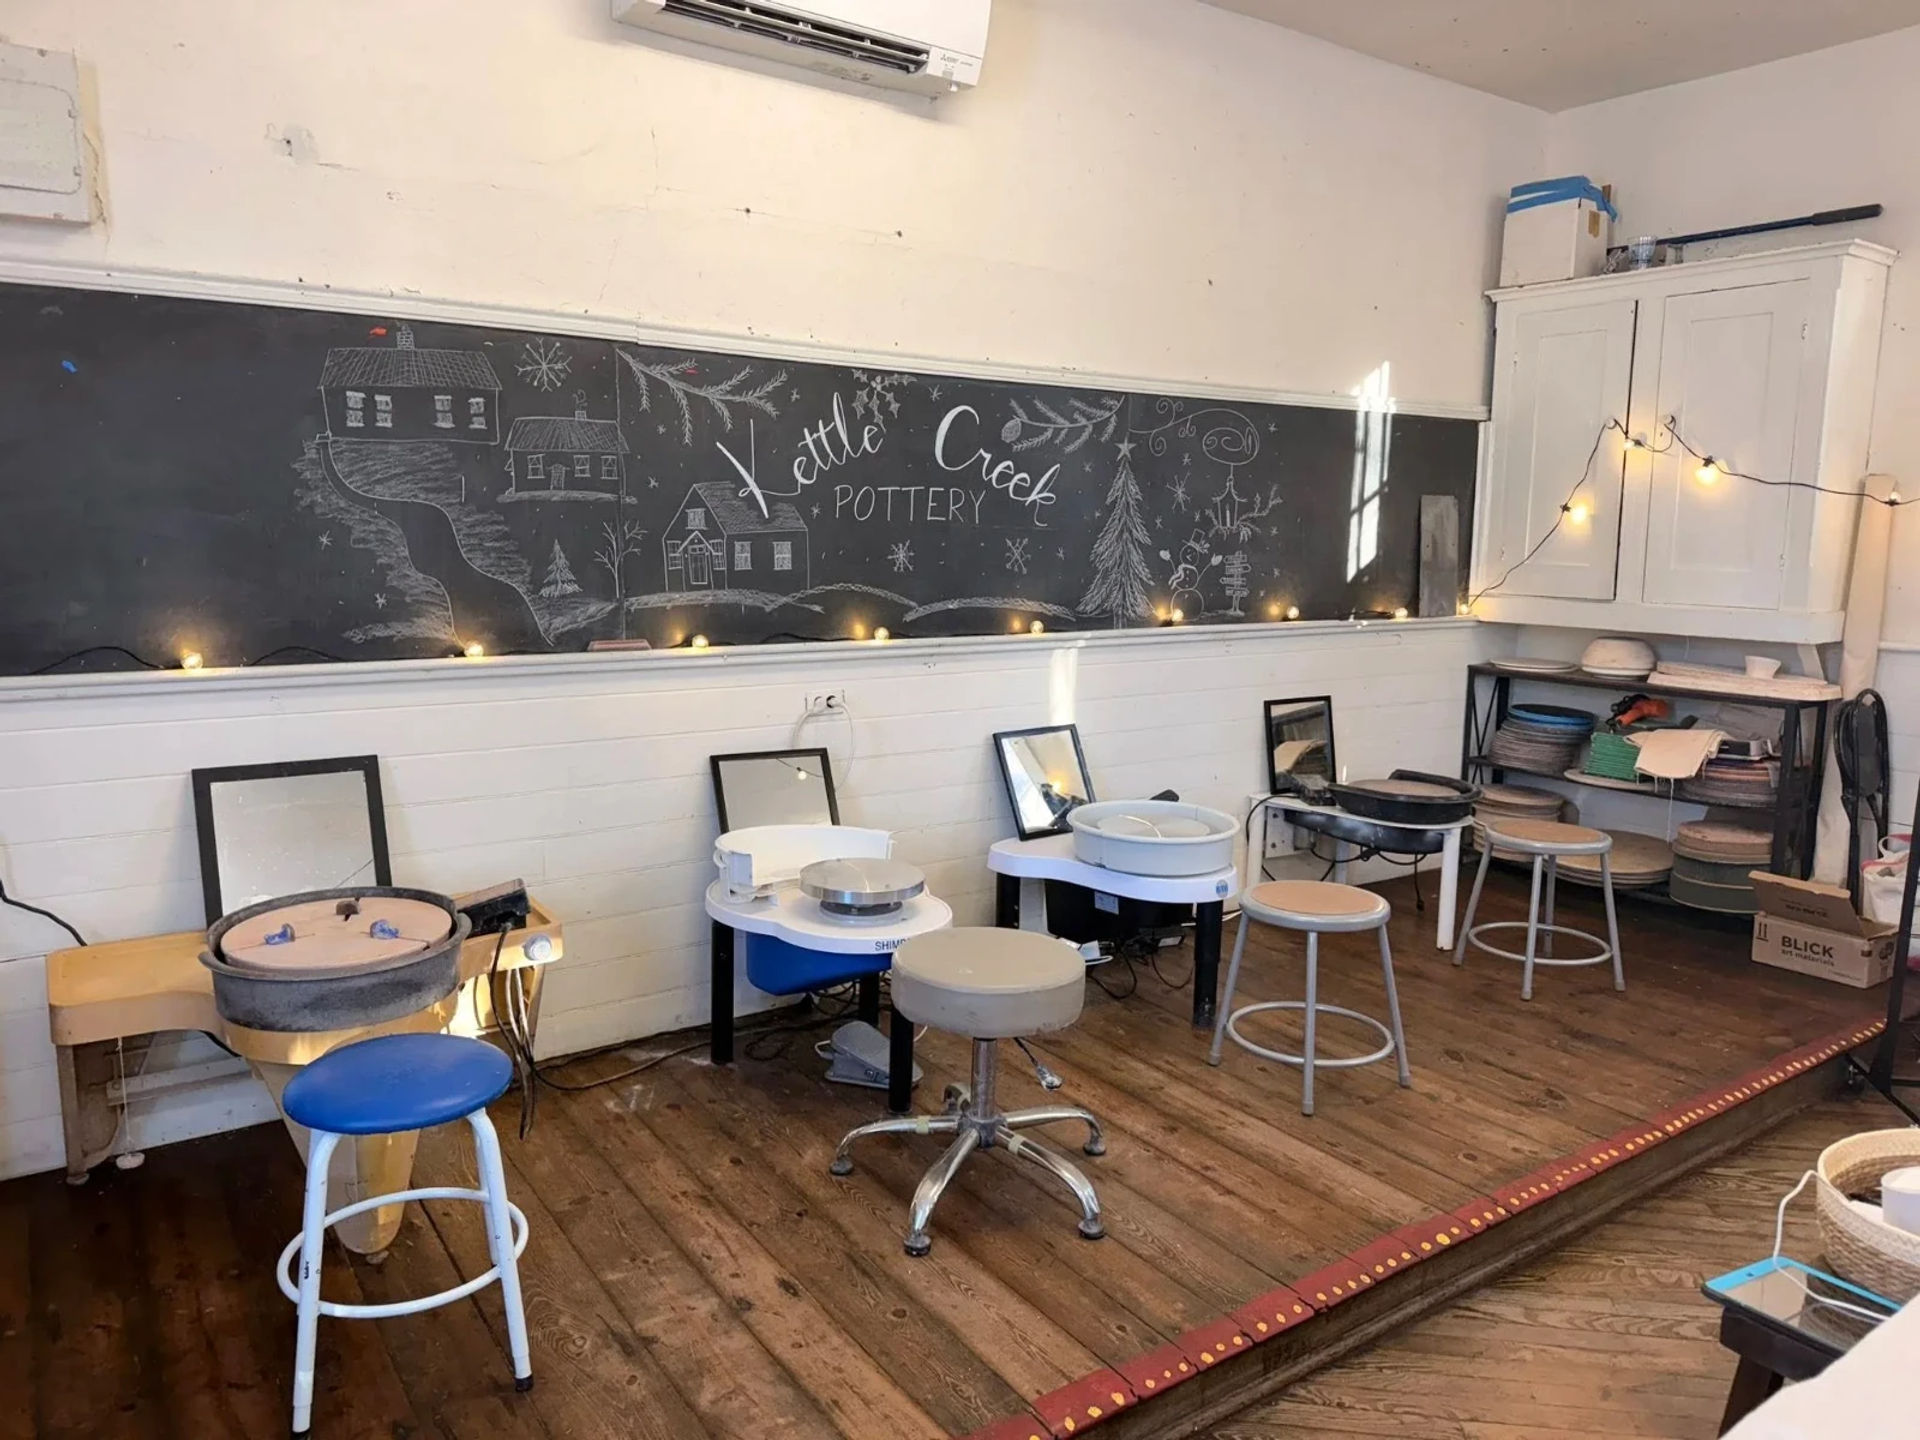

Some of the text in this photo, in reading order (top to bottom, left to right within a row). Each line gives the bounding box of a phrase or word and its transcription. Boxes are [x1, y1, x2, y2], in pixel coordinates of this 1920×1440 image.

[715, 391, 1061, 527] Kettle Creek
[834, 484, 986, 525] POTTERY
[874, 938, 910, 952] SHIM
[1781, 935, 1834, 959] BLICK
